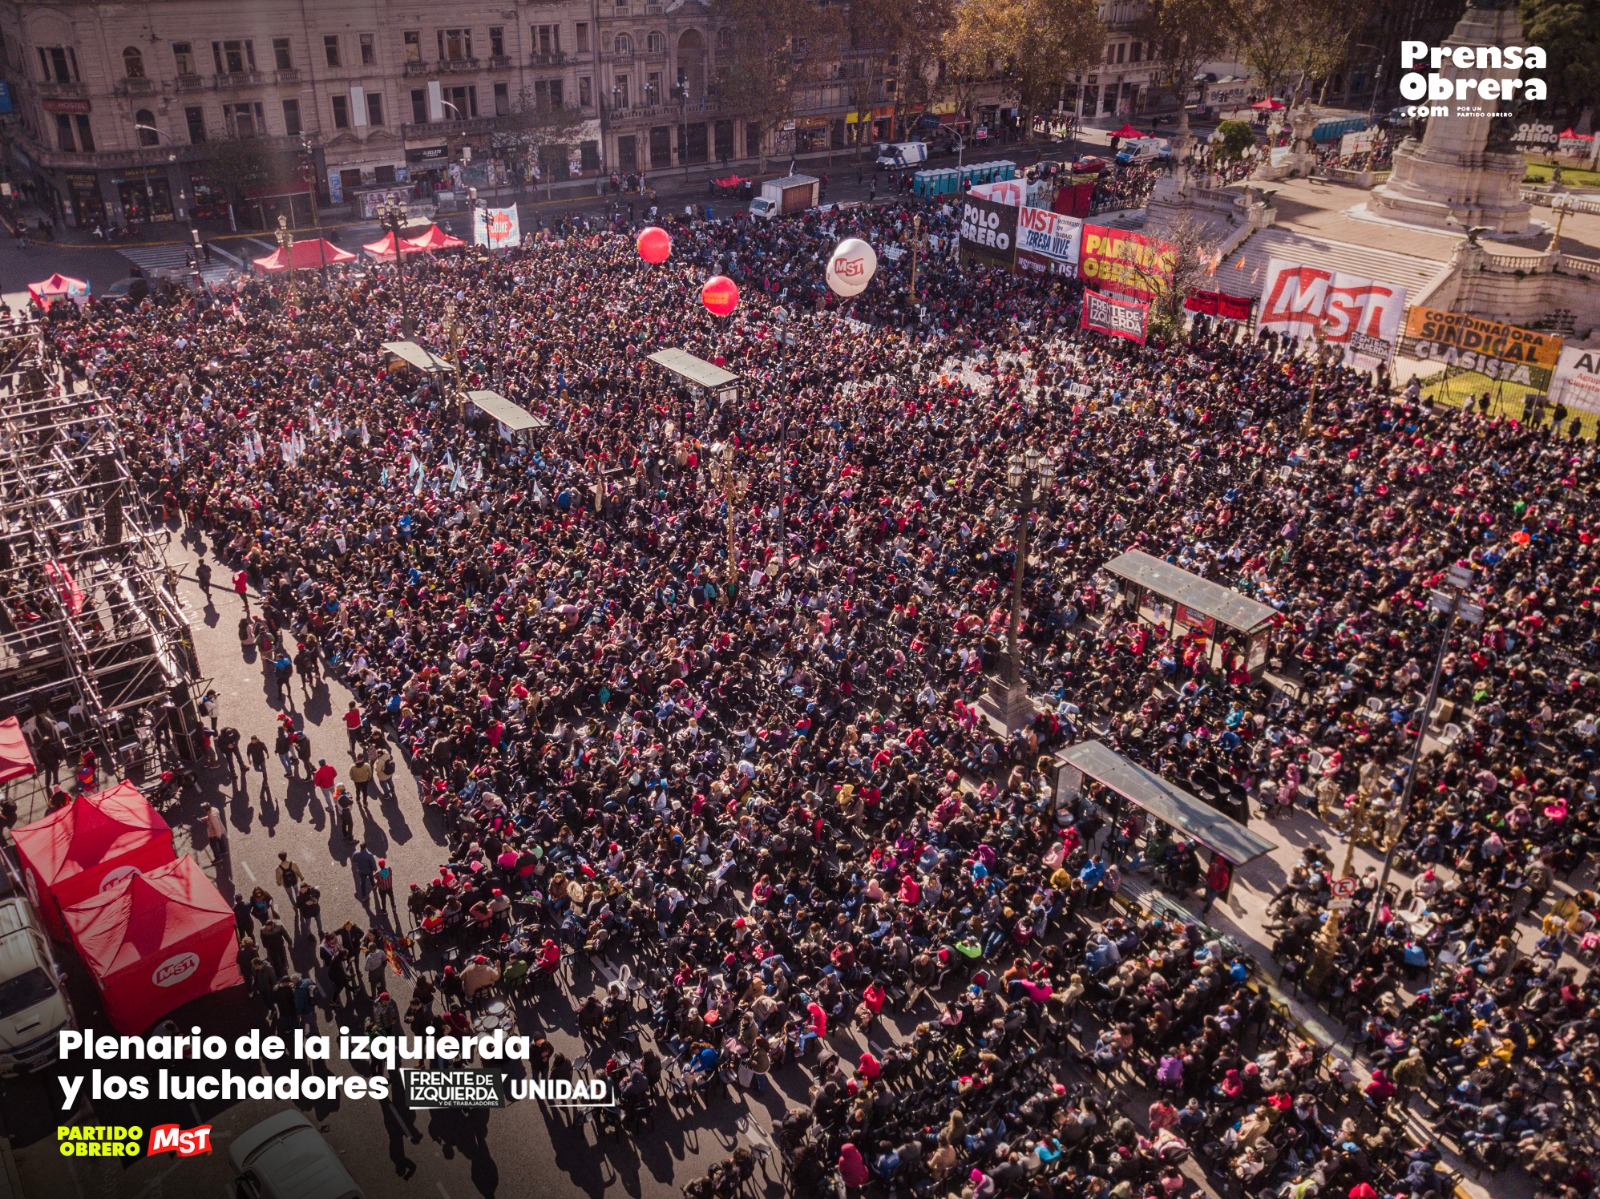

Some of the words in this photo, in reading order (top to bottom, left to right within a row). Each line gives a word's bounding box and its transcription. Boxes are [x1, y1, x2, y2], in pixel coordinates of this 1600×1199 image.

[964, 203, 1000, 231] POLO
[1021, 207, 1058, 235] MST
[1026, 230, 1051, 250] TERESA
[1052, 237, 1070, 256] VIVE
[1086, 234, 1176, 273] PARTIDO
[835, 257, 865, 277] MST
[1083, 257, 1167, 295] OBRERO
[1125, 310, 1140, 321] DE
[1269, 269, 1392, 338] MST
[1420, 322, 1539, 363] SINDICAL
[1425, 311, 1543, 347] COORDINADORA
[1415, 340, 1532, 386] CLASISTA
[157, 956, 195, 984] MST
